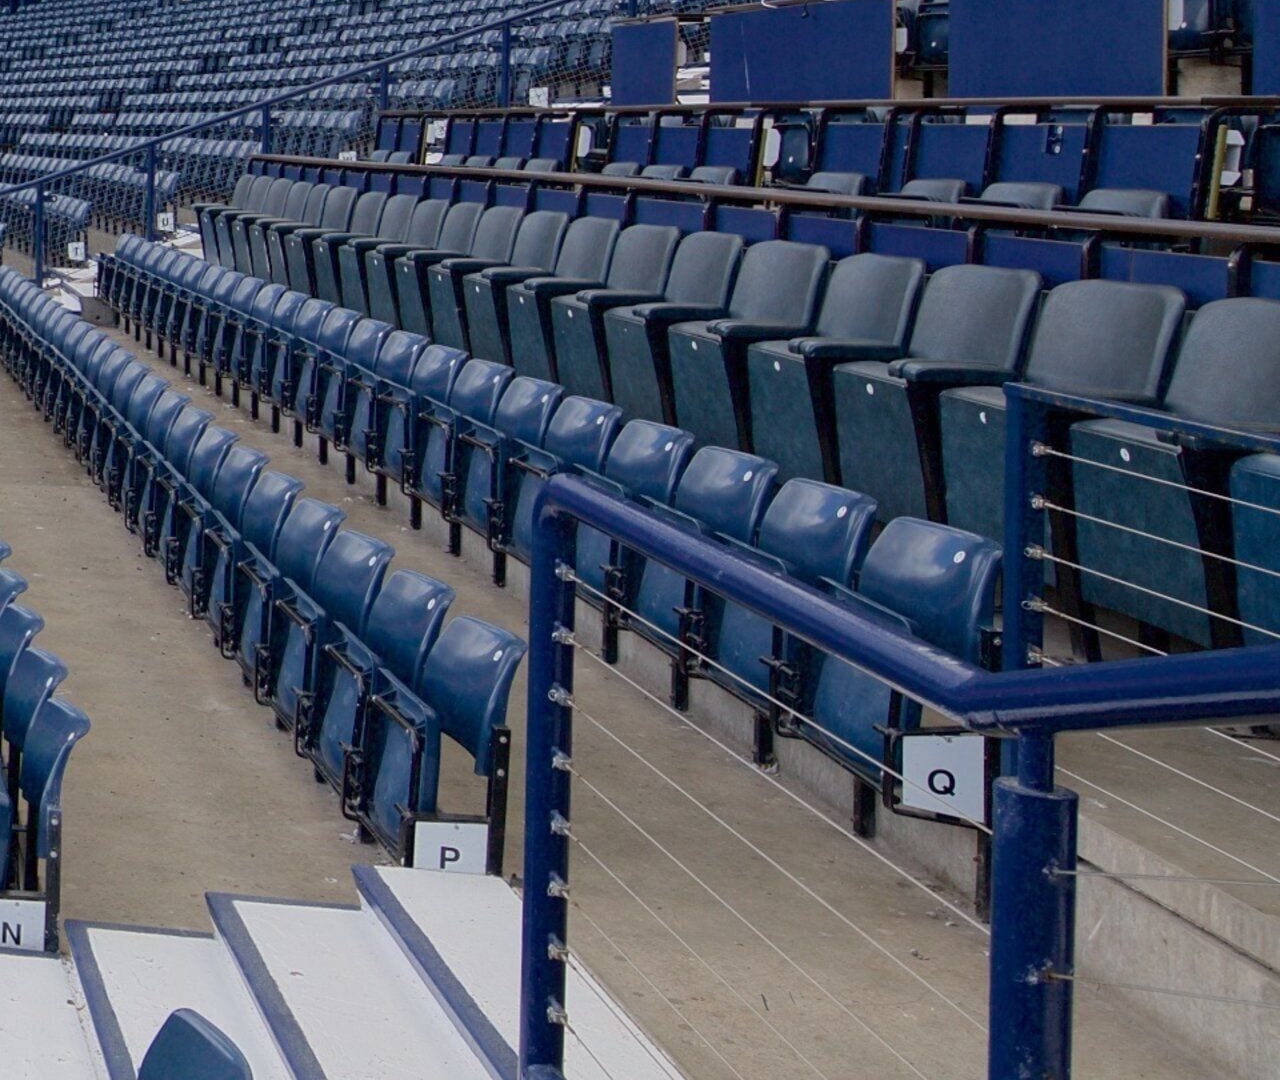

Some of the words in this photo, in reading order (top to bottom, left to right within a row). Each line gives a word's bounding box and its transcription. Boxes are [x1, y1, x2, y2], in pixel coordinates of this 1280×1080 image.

[927, 769, 956, 796] Q
[440, 846, 460, 869] P
[1, 922, 21, 945] N
